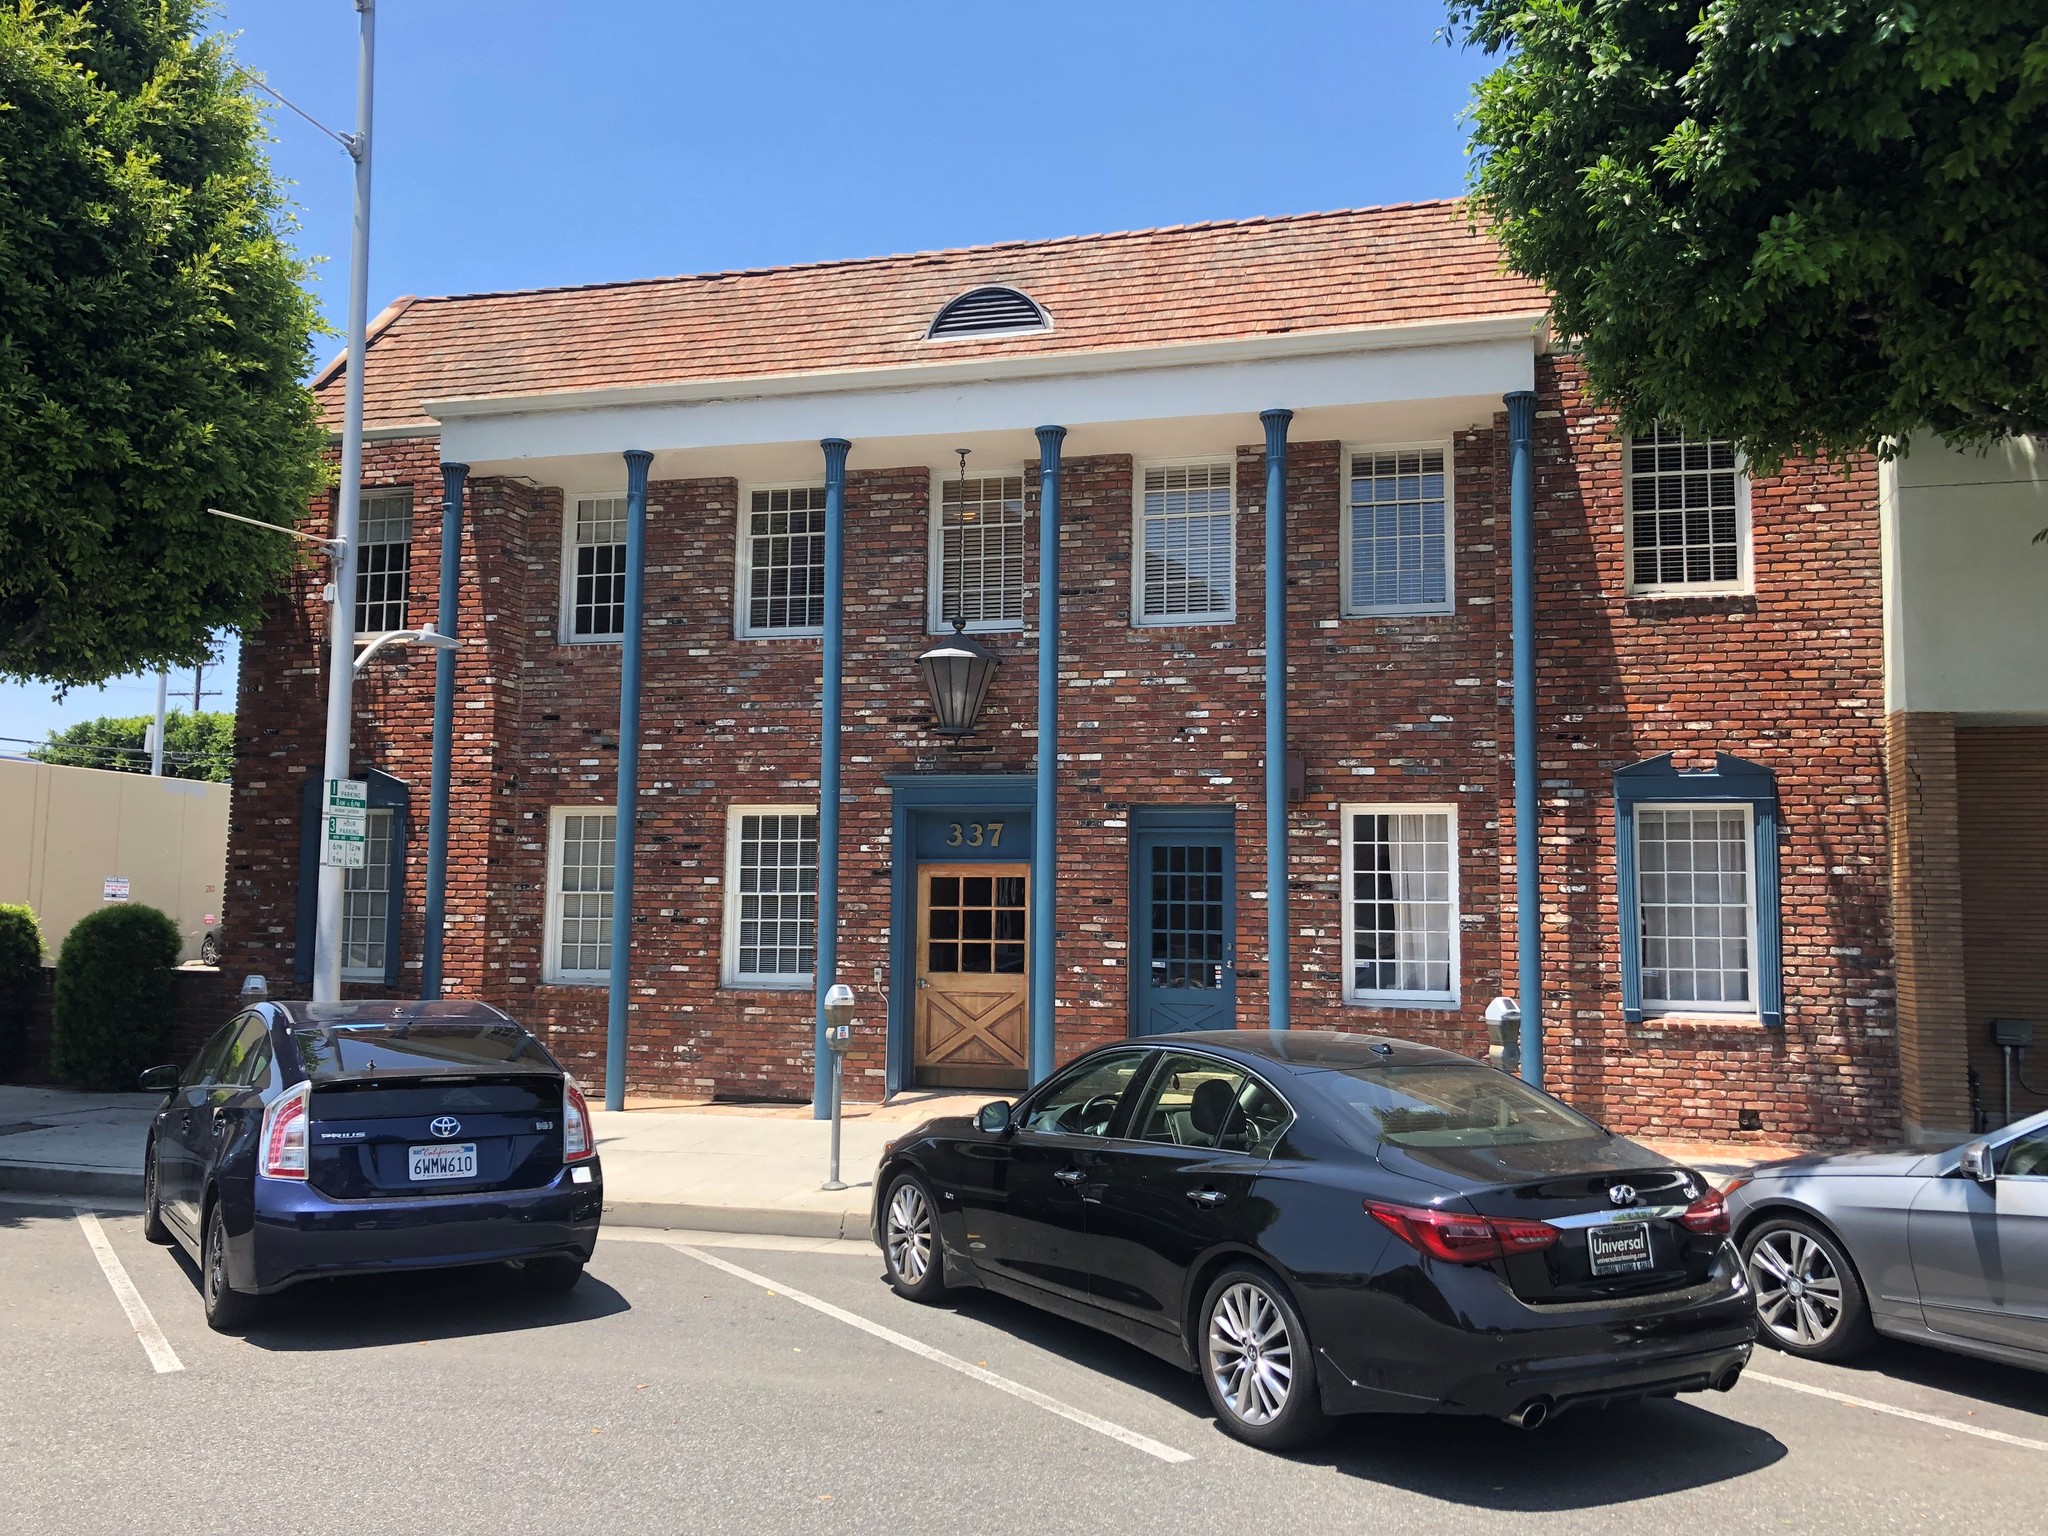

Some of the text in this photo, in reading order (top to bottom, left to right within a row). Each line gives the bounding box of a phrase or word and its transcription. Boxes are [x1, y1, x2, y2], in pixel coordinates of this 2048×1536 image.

[330, 818, 336, 831] 3
[946, 823, 1004, 847] 337
[423, 1148, 464, 1157] California
[414, 1156, 472, 1175] 6WMW610
[1593, 1231, 1644, 1255] Universal
